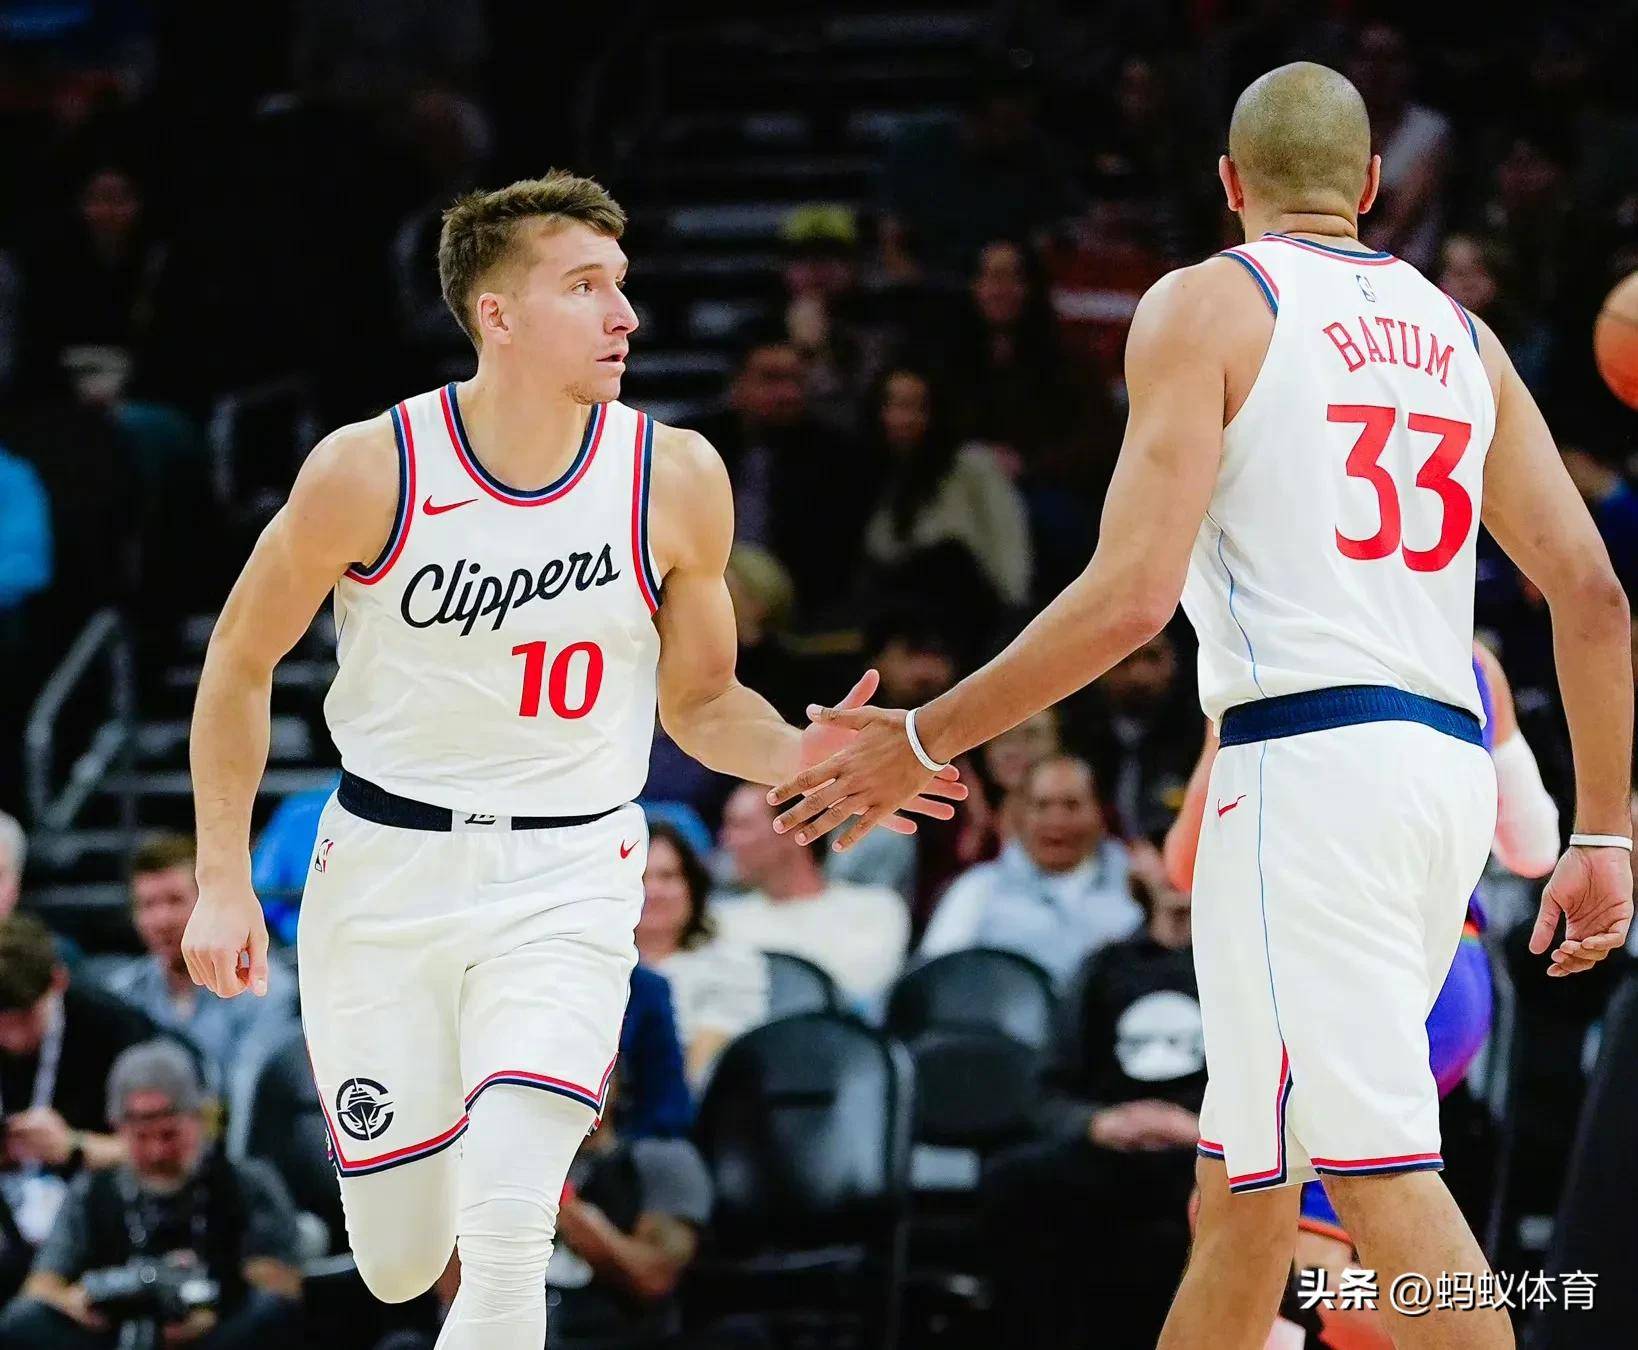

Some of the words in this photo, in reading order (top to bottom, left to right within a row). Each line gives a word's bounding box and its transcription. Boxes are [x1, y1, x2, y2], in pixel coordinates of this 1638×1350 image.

[1322, 316, 1455, 387] BATUM
[1326, 403, 1473, 572] 33
[401, 543, 621, 637] Clippers
[511, 640, 604, 720] 10
